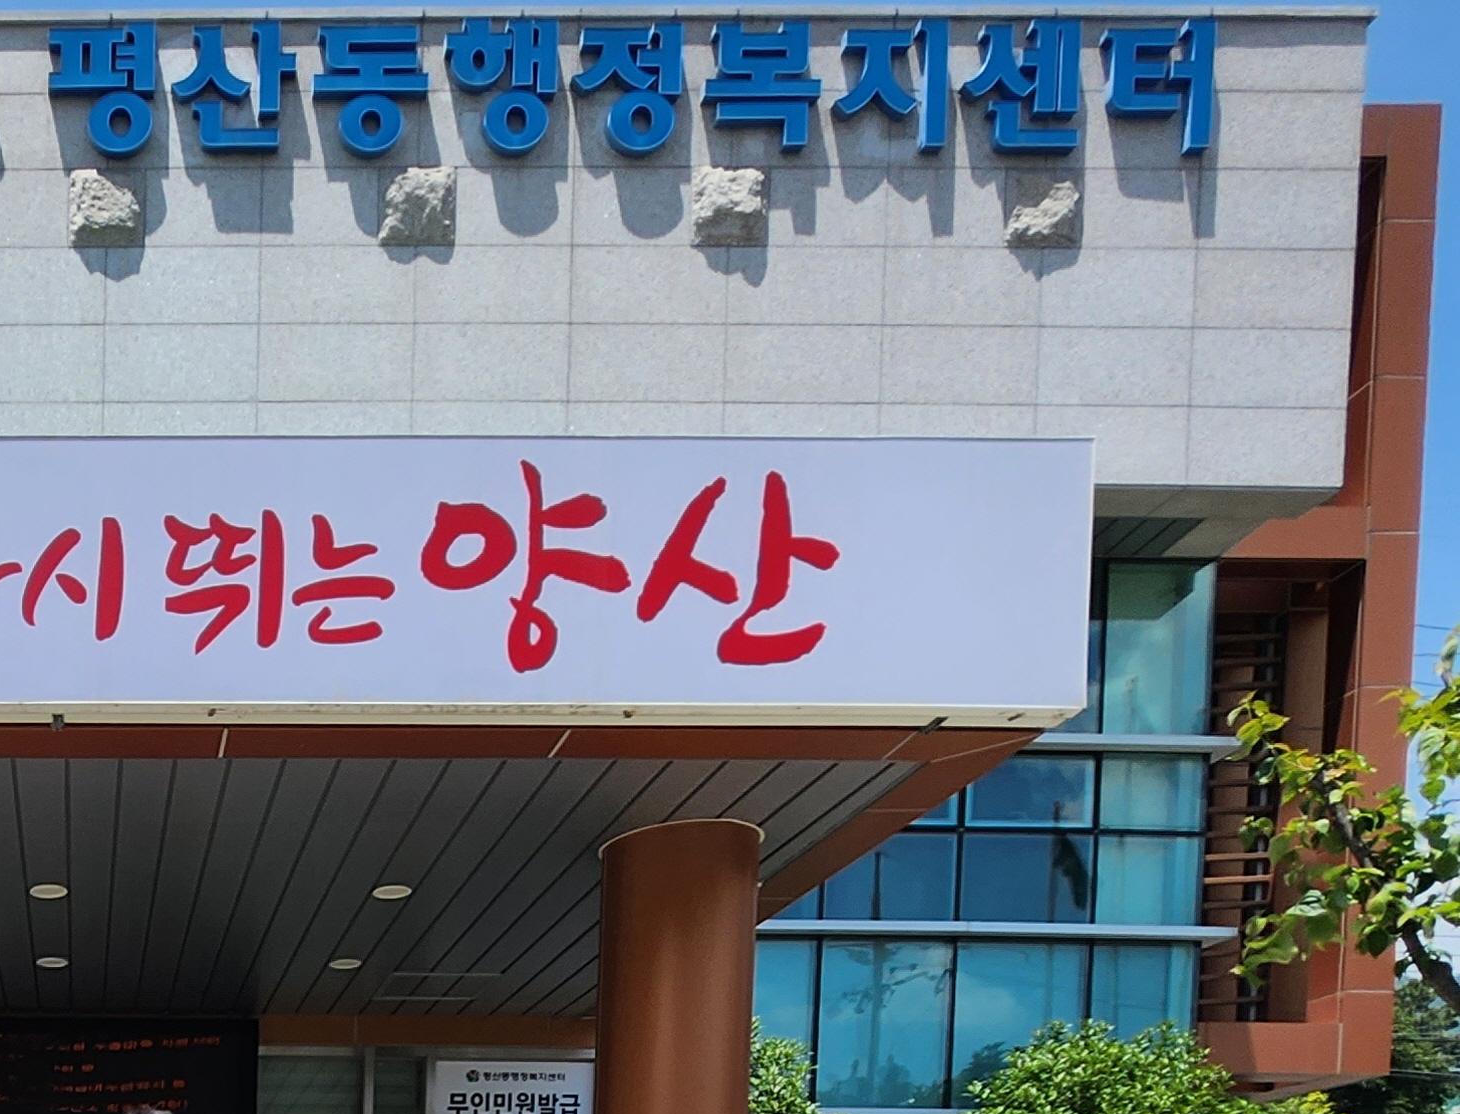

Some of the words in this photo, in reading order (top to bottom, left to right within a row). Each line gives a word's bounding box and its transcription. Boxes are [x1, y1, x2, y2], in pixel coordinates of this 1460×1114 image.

[47, 16, 1215, 160] 평산동행정복지센터
[163, 510, 396, 653] 뛰는
[419, 460, 841, 673] 양산
